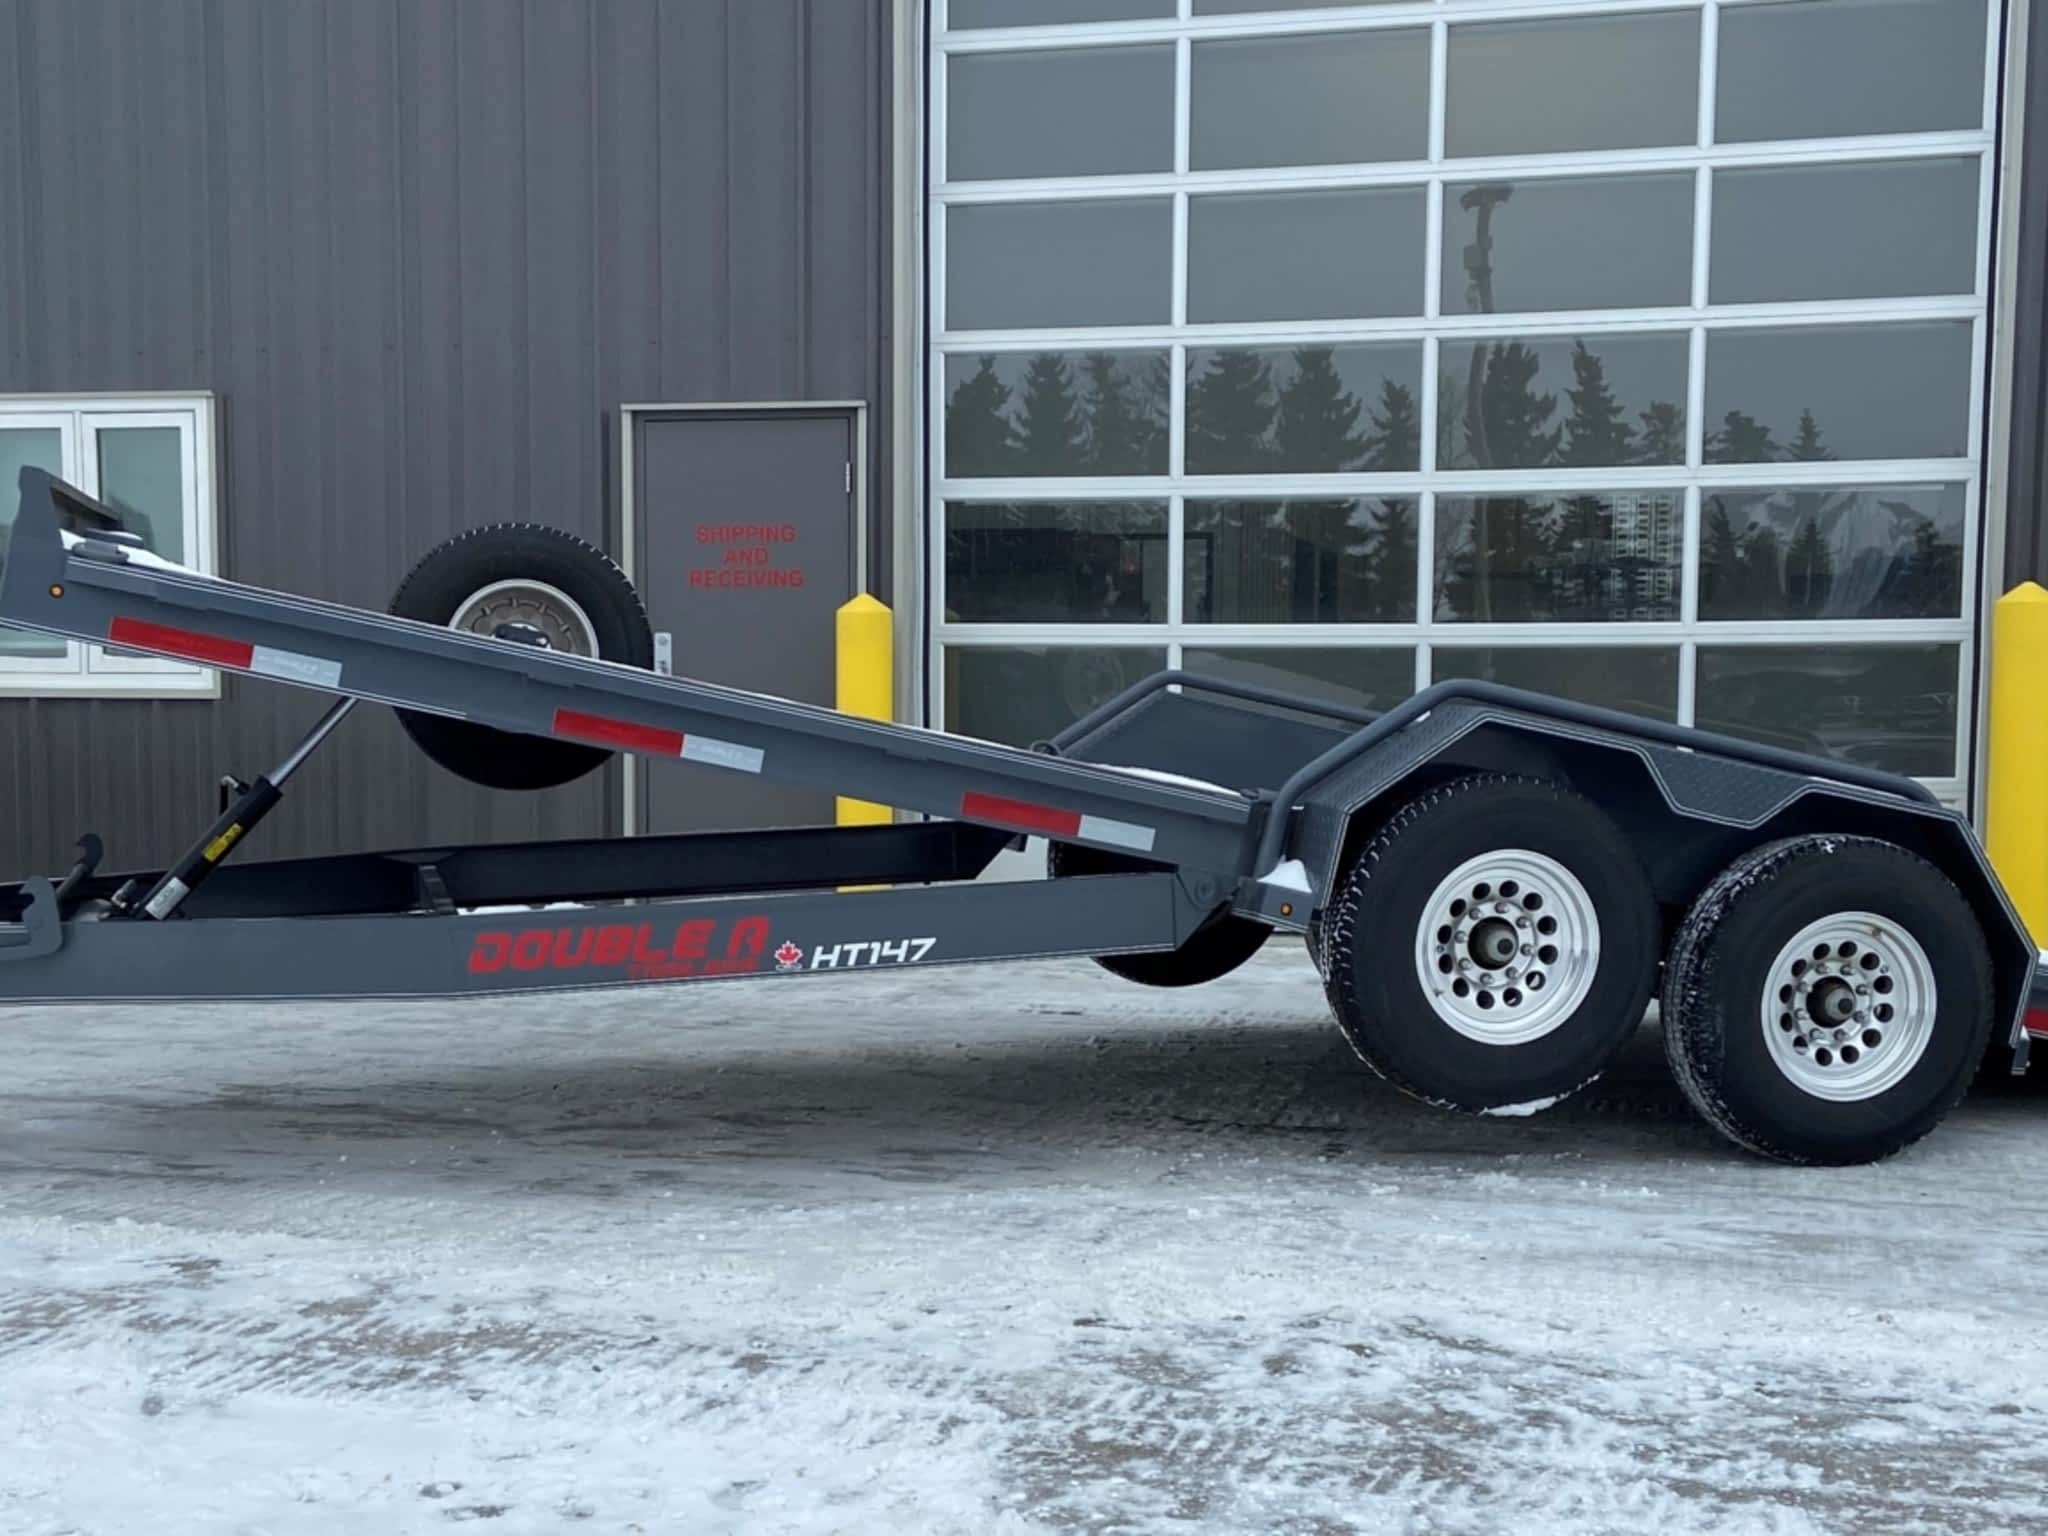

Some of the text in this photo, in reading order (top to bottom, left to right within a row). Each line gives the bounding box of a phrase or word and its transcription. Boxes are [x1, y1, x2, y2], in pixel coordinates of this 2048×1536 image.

[696, 524, 795, 544] SHIPPING
[724, 547, 769, 566] AND
[688, 568, 805, 588] RECEIVING
[468, 919, 716, 974] DOUBLE
[727, 915, 771, 959] A
[810, 937, 937, 969] HT147
